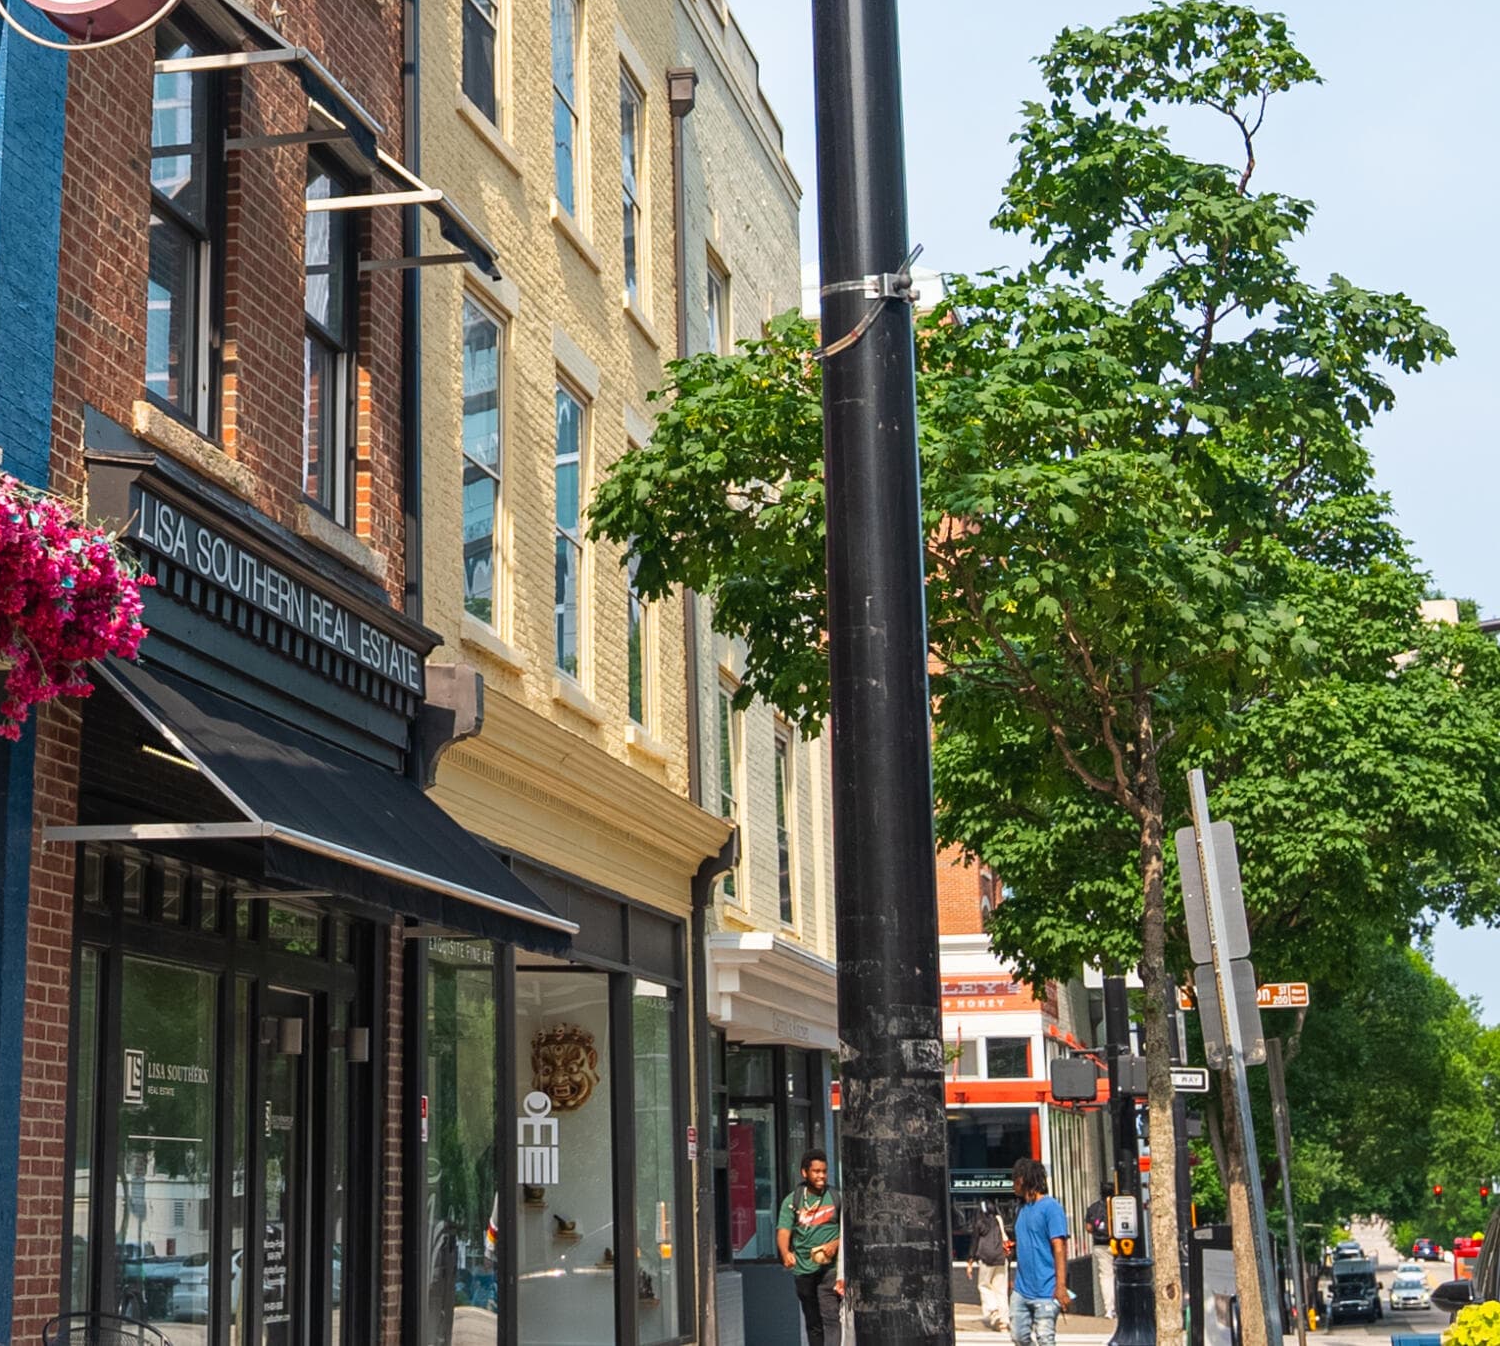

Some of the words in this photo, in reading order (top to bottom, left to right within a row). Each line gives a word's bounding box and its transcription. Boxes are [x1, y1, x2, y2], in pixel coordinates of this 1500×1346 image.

[138, 491, 190, 566] LISA
[196, 528, 304, 630] SOUTHERN
[310, 594, 355, 657] REAL
[360, 621, 419, 690] ESTATE
[148, 1062, 166, 1079] LISA
[167, 1063, 209, 1084] SOUTHERN
[1181, 1074, 1198, 1083] WAY
[953, 1179, 1014, 1188] KINDNE
